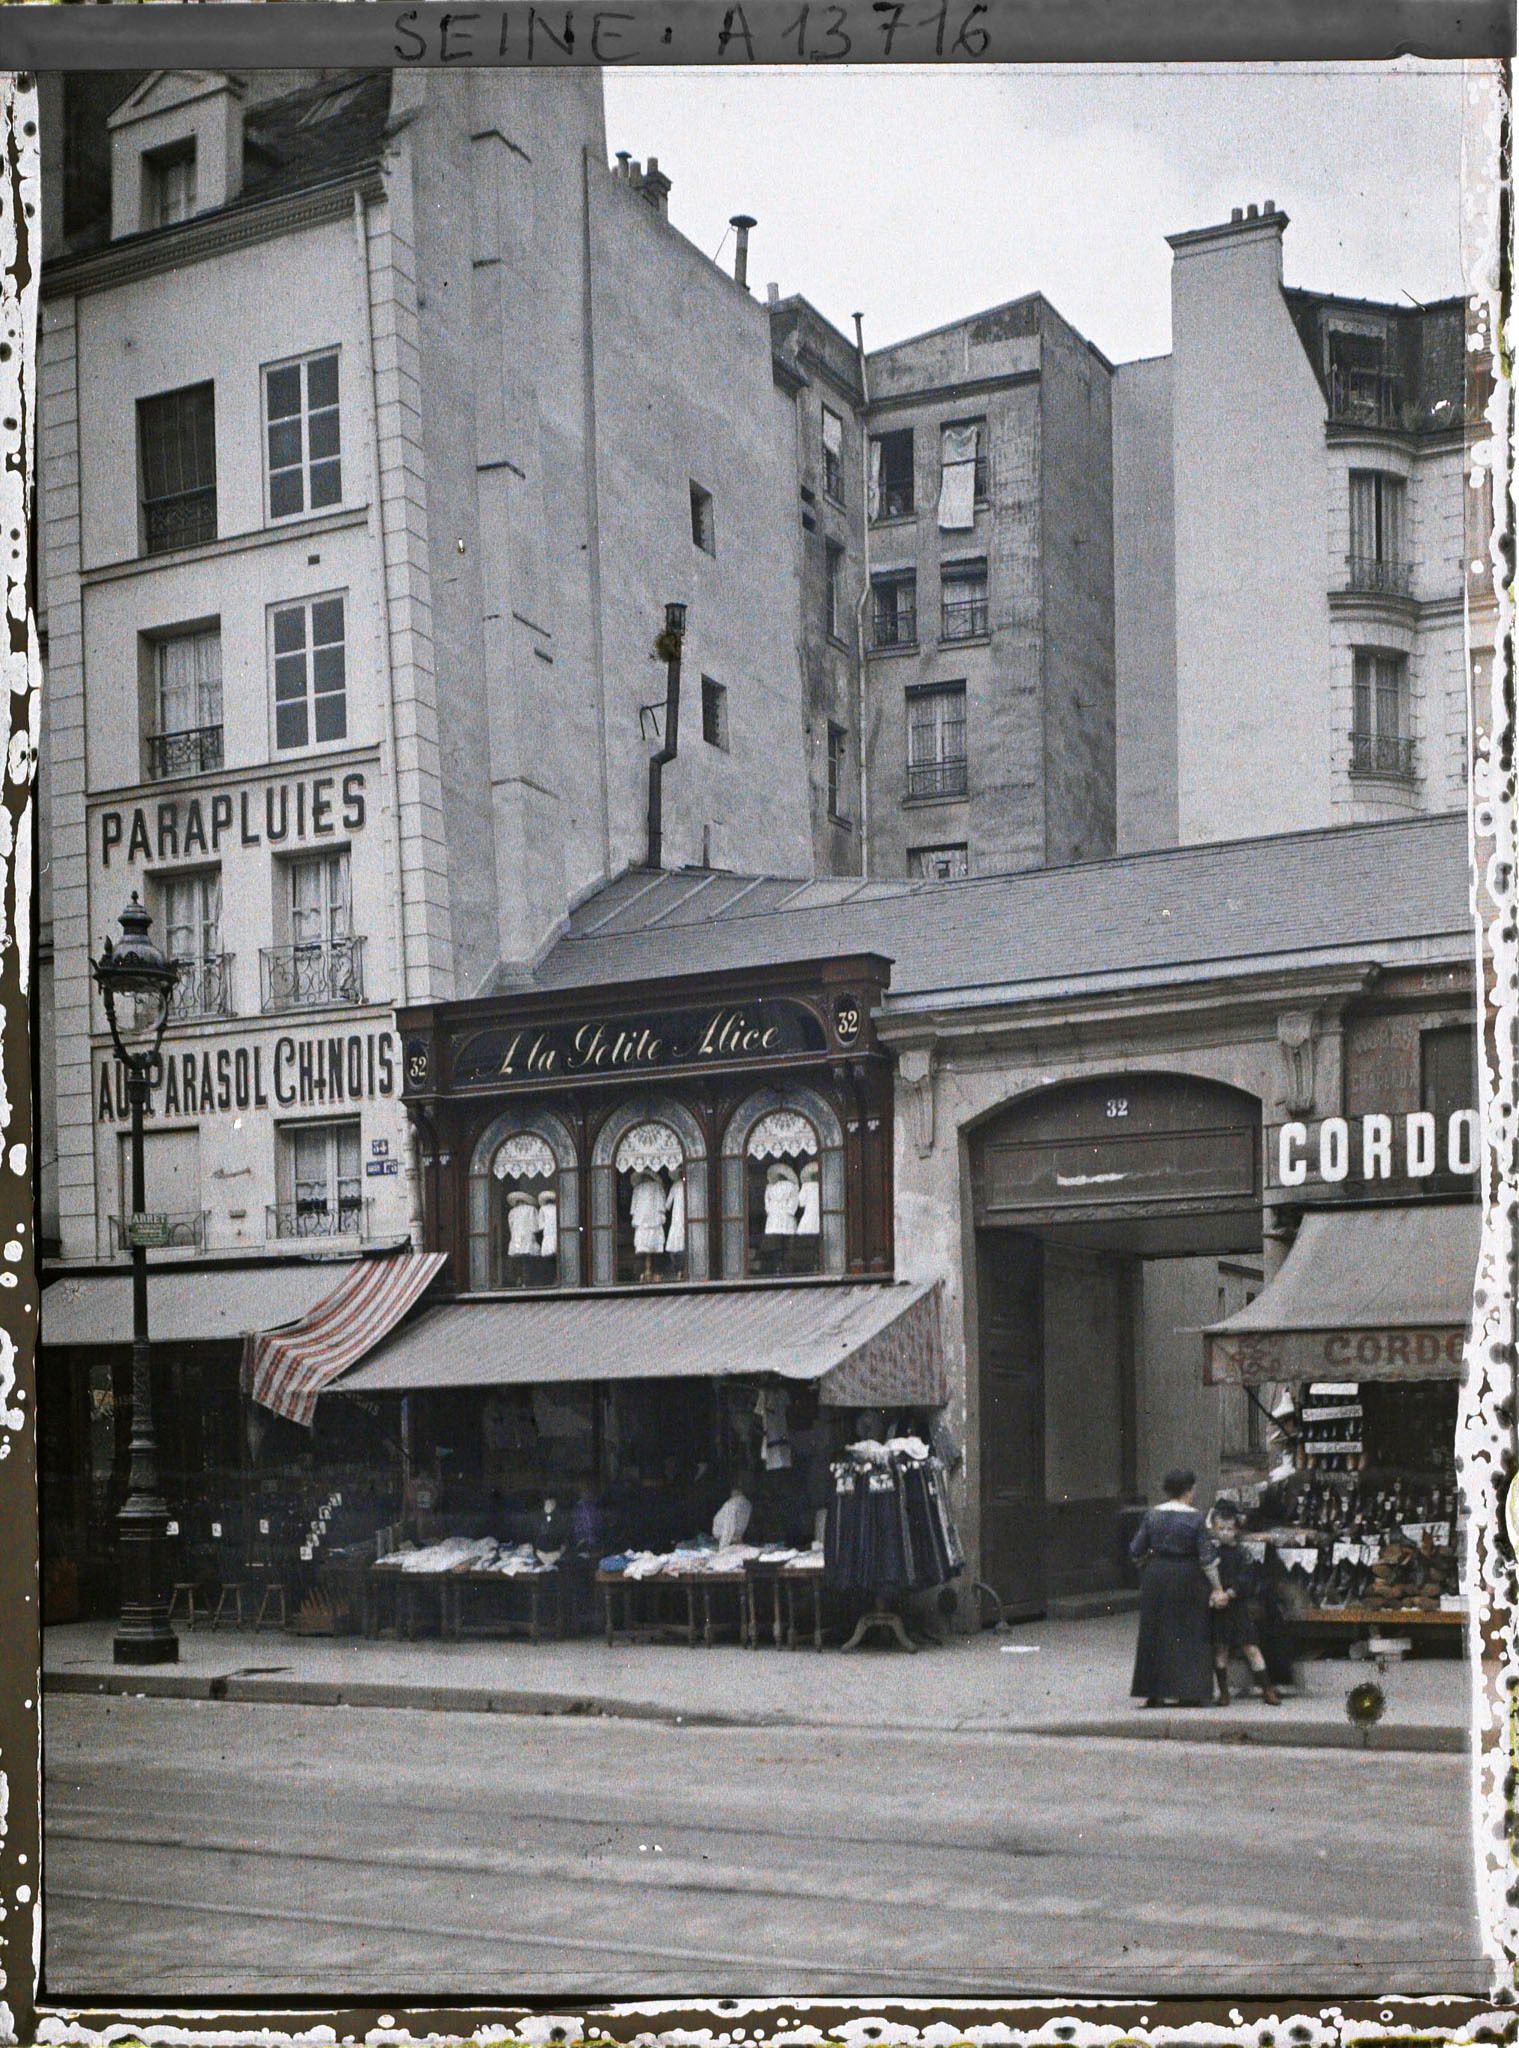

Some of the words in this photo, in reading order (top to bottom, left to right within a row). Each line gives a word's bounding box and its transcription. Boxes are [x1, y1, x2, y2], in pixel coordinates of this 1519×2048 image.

[102, 772, 366, 869] PARAPLUIES
[527, 1032, 557, 1073] la
[567, 1022, 664, 1068] Petite
[673, 1010, 781, 1057] Alice
[838, 1010, 858, 1034] 32
[98, 1060, 131, 1122] AU
[143, 1045, 268, 1118] PARASOL
[409, 1055, 427, 1077] 32
[1106, 1098, 1129, 1118] 32
[1278, 1108, 1481, 1187] CORDO
